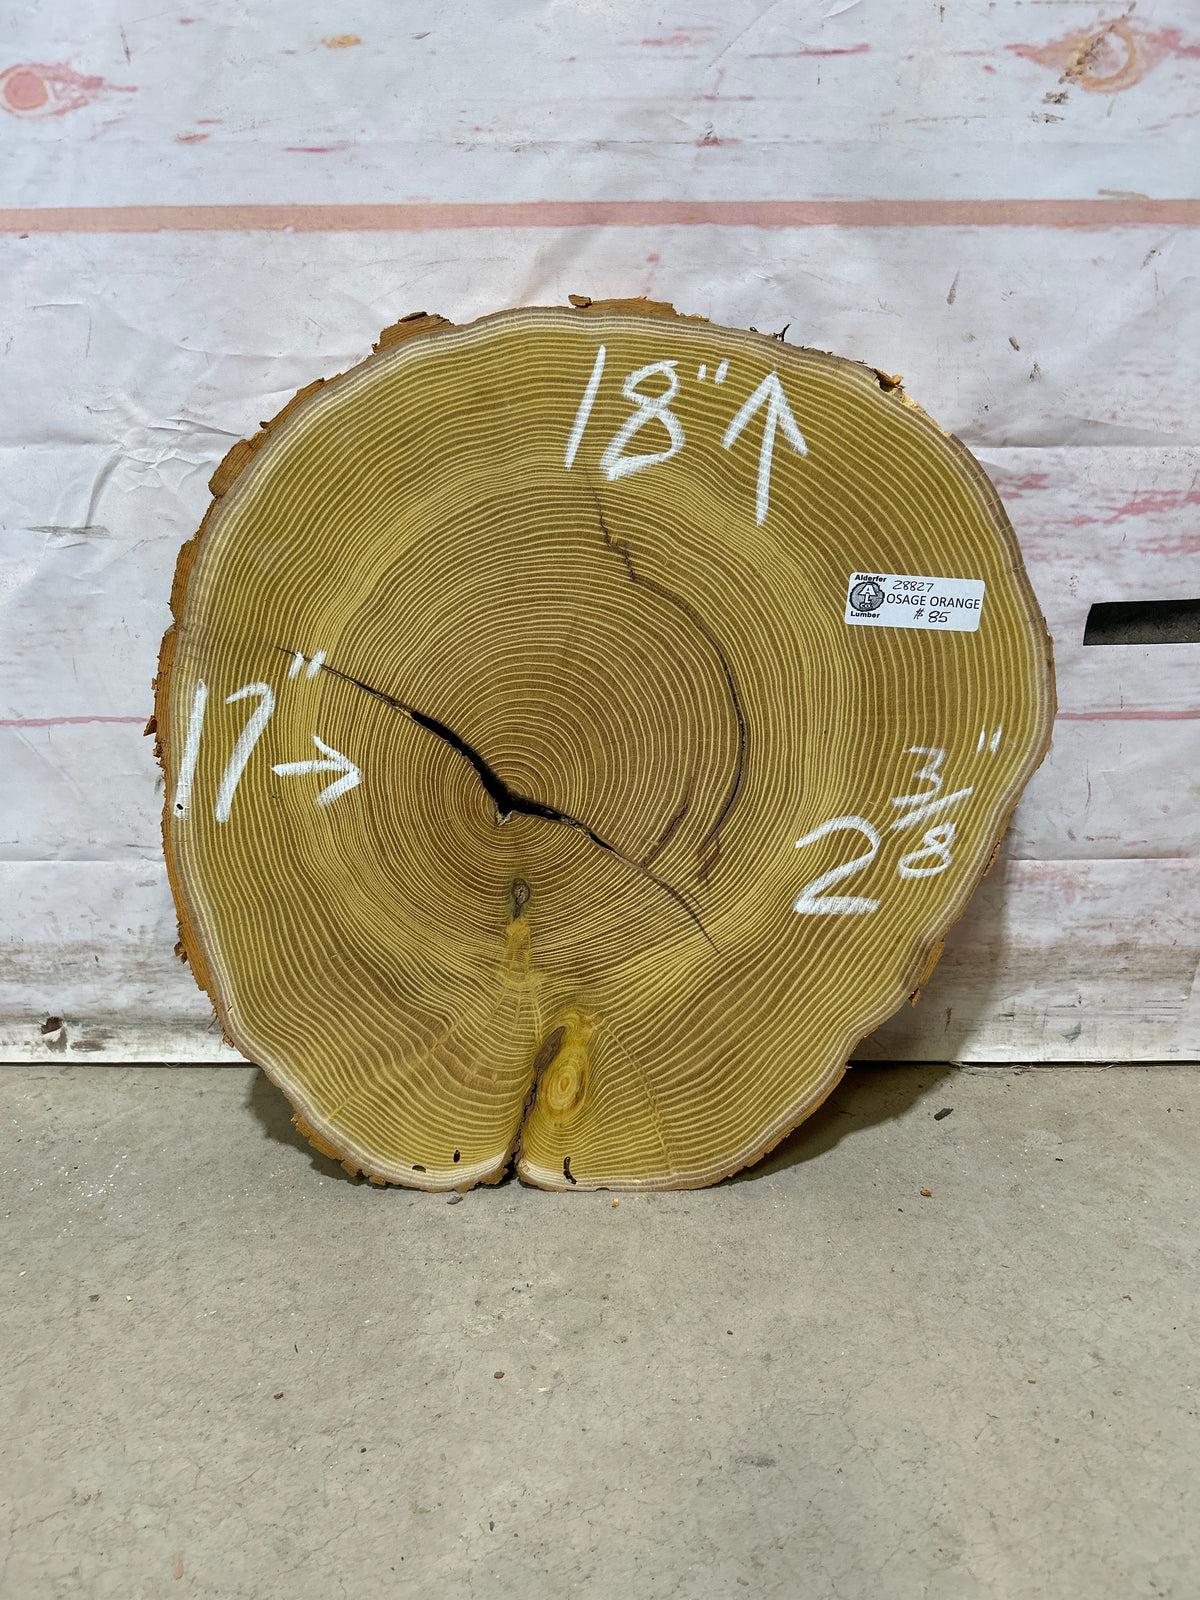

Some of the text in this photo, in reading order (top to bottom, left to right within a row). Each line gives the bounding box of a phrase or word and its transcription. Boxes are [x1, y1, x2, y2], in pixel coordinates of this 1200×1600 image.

[564, 345, 729, 481] 18"
[855, 574, 887, 582] Alderfer
[892, 580, 935, 592] 28827
[886, 593, 981, 609] OSAGE ORANGE
[850, 610, 881, 618] Lumber
